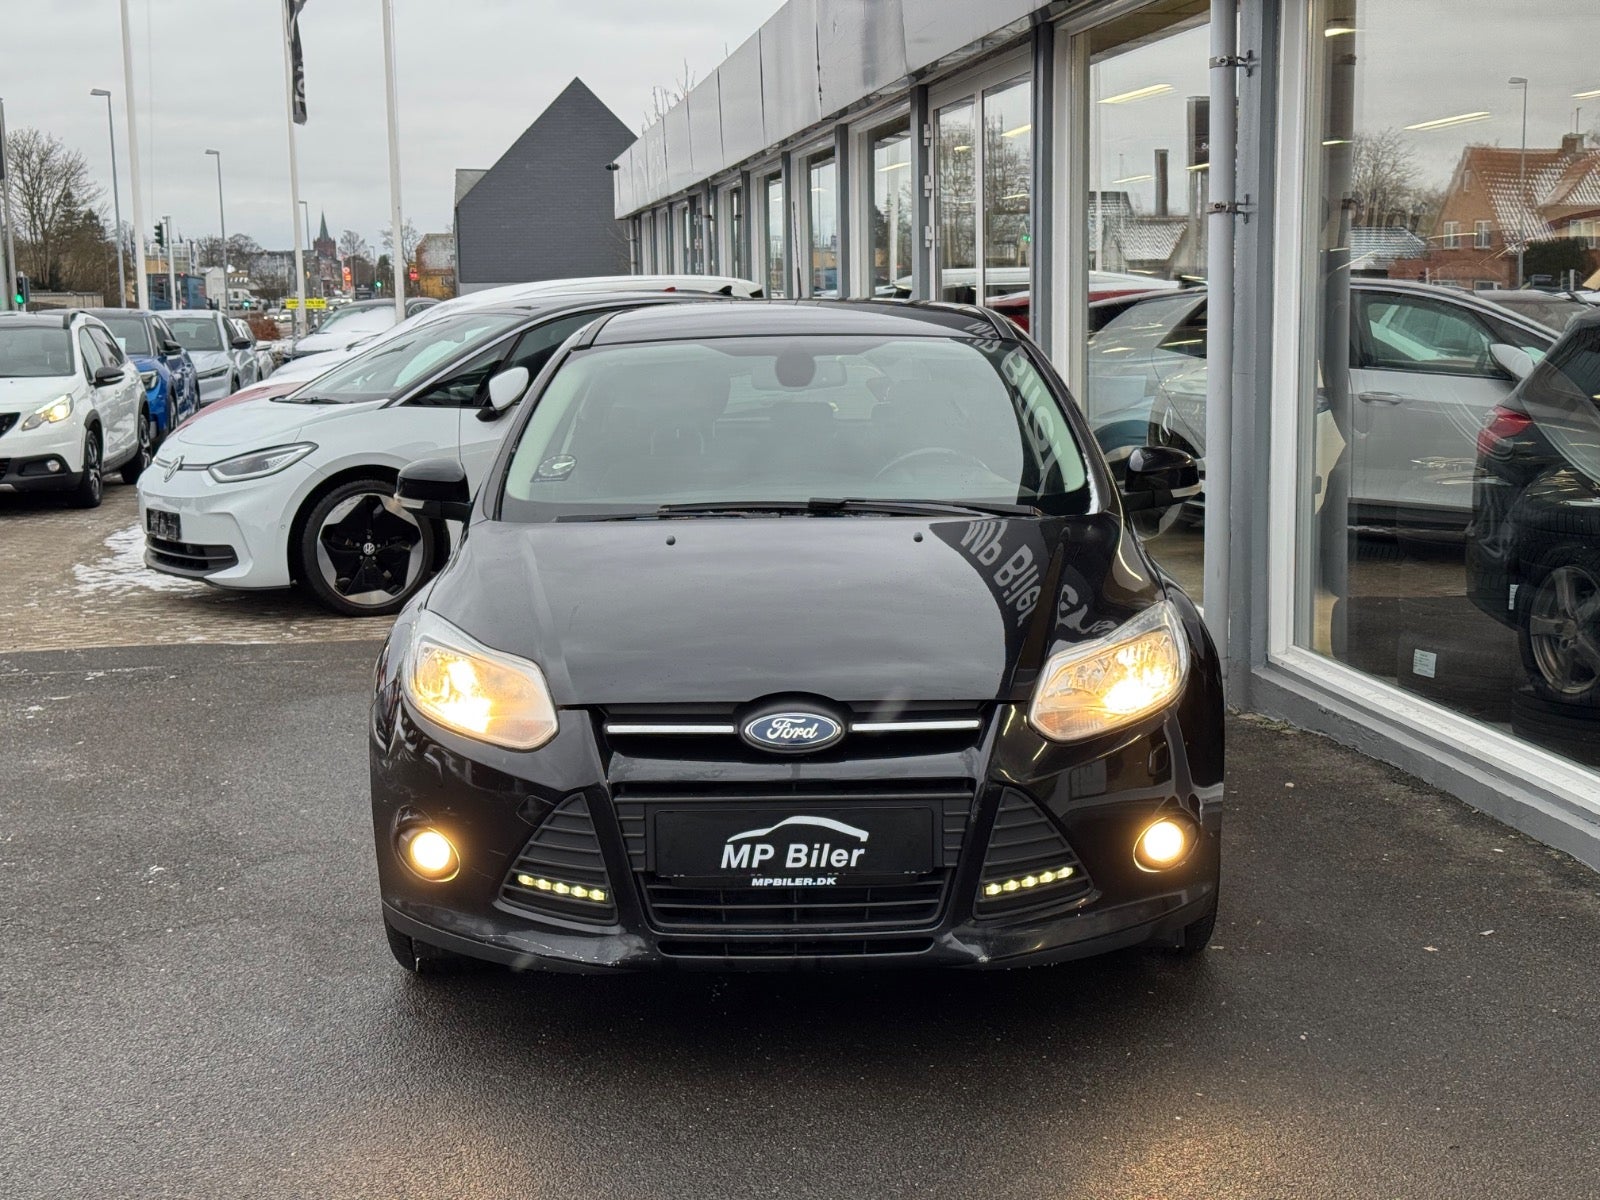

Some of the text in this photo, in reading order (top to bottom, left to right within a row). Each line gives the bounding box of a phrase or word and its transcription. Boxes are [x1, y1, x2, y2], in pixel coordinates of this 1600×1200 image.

[766, 717, 819, 740] Ford
[720, 843, 866, 869] MP Biler
[751, 877, 838, 886] MPBILER.DK
